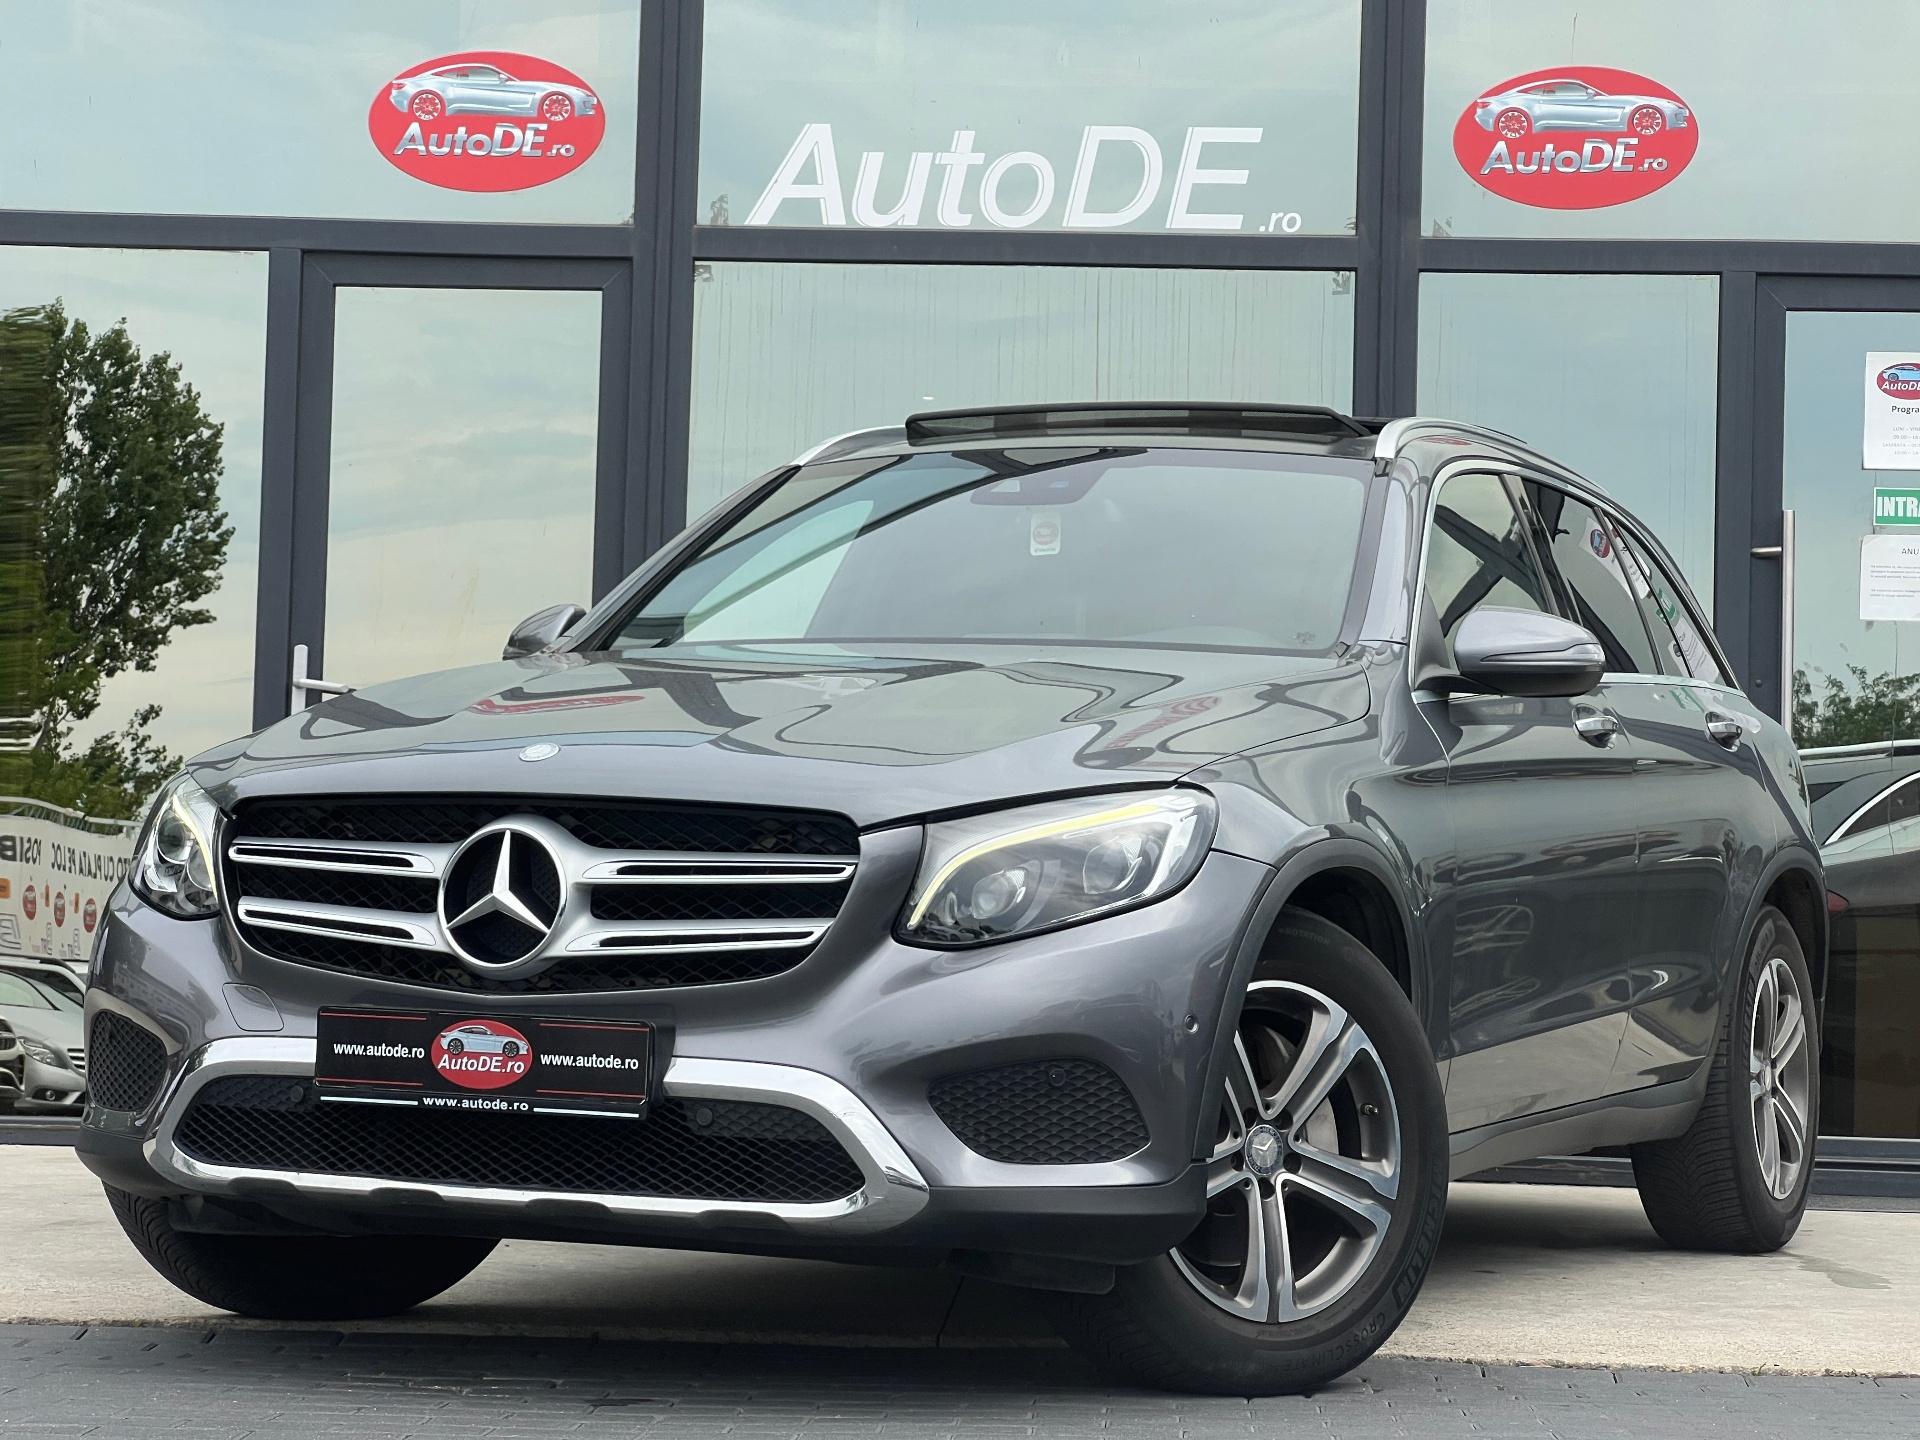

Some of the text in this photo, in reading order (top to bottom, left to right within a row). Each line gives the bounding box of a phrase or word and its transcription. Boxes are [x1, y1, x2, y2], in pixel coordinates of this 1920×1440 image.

[1877, 496, 1920, 518] INTR
[333, 1041, 425, 1059] www.autode.ro
[540, 1053, 639, 1070] www.autode.ro
[423, 1096, 529, 1112] www.autode.ro
